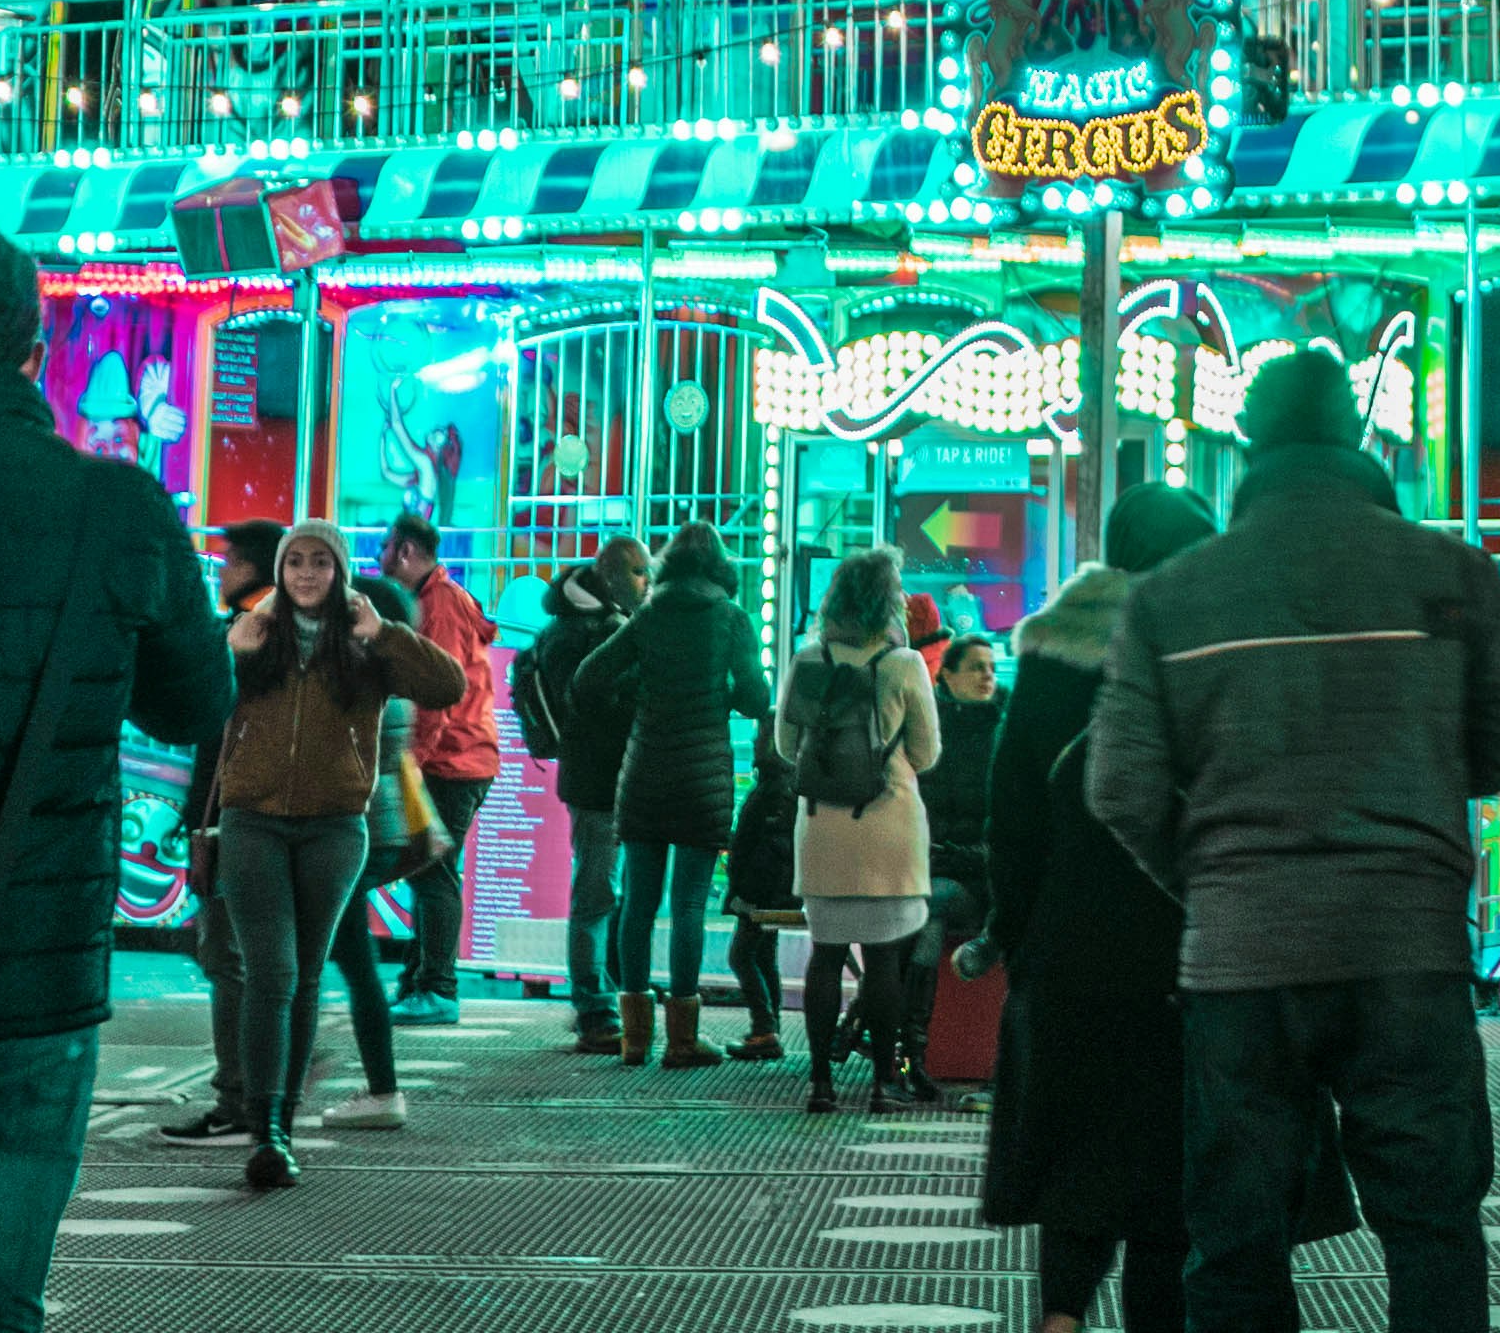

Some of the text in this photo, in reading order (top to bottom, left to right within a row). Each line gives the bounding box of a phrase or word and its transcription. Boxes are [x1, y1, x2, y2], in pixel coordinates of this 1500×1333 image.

[1020, 60, 1153, 111] MAGIC
[972, 89, 1209, 180] CIRCUS
[936, 446, 1011, 465] TAP & RIDE!
